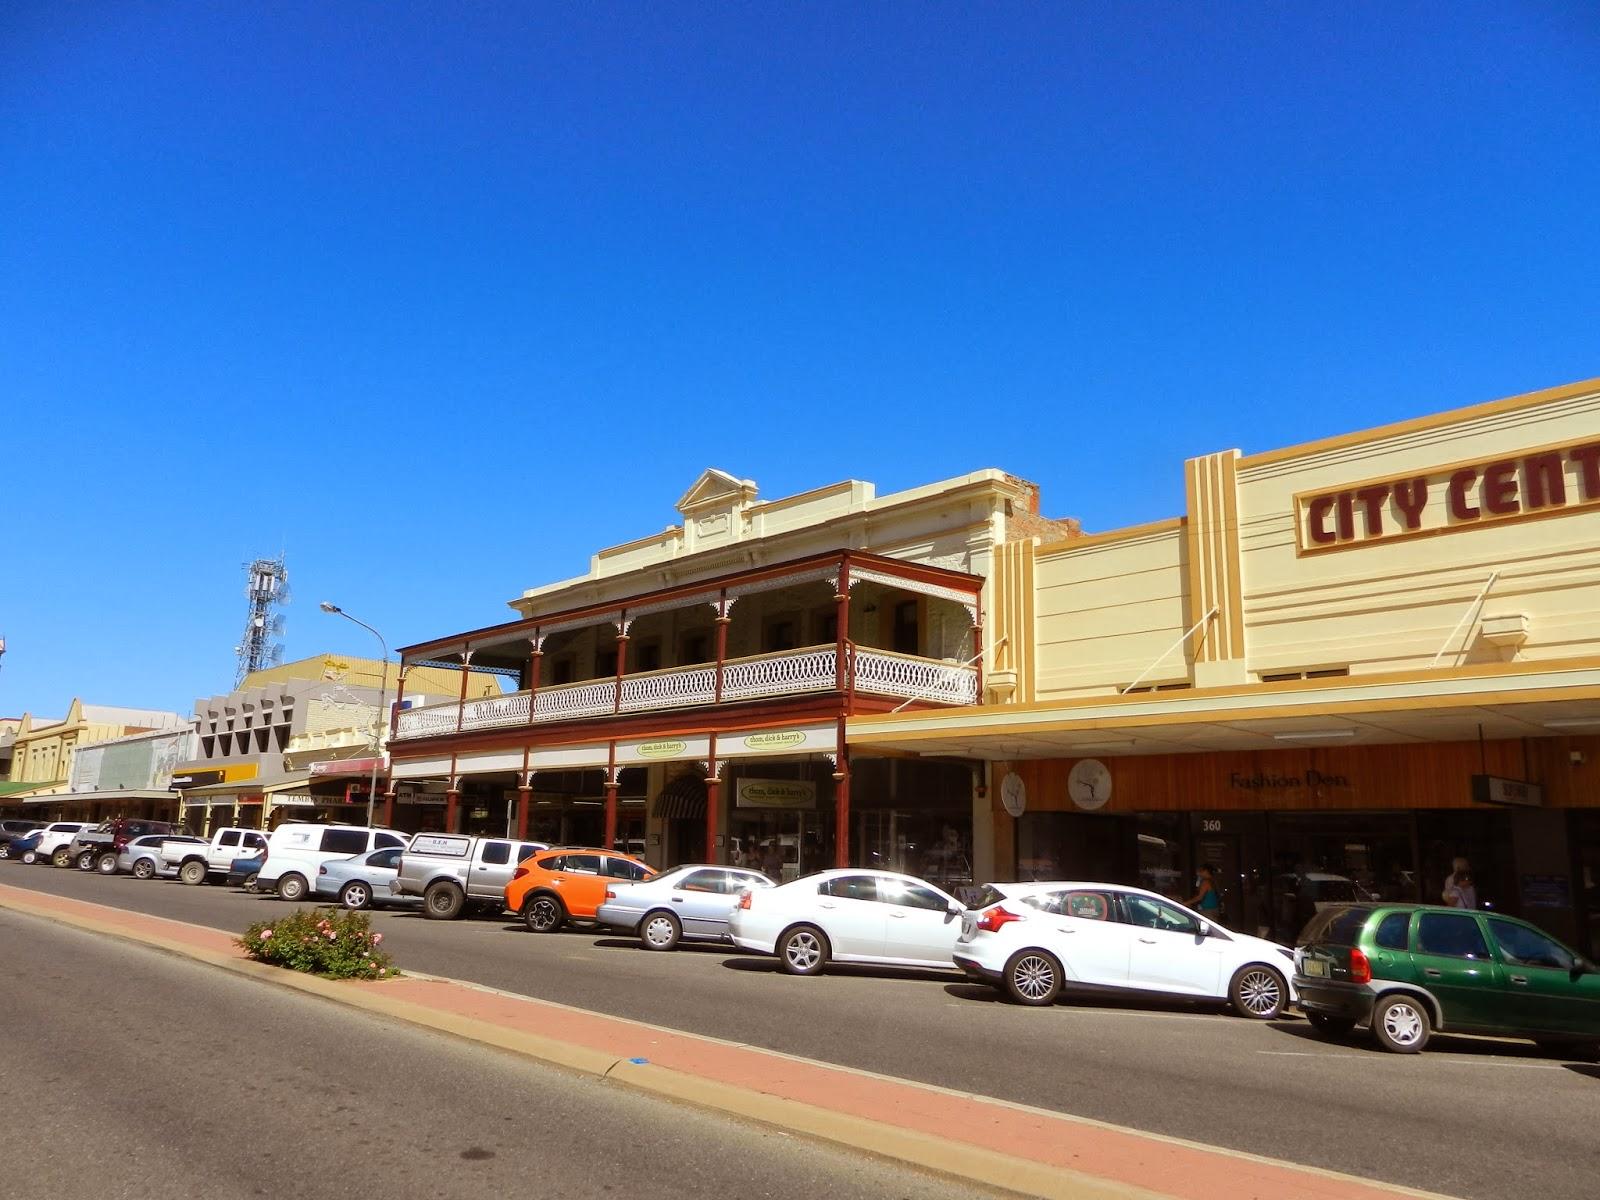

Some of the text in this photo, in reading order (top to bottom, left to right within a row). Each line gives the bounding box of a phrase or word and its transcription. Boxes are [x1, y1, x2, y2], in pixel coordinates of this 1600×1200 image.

[1309, 478, 1428, 543] CITY
[765, 734, 776, 742] dick
[1230, 770, 1347, 788] Fashion Den
[1202, 819, 1221, 831] 360
